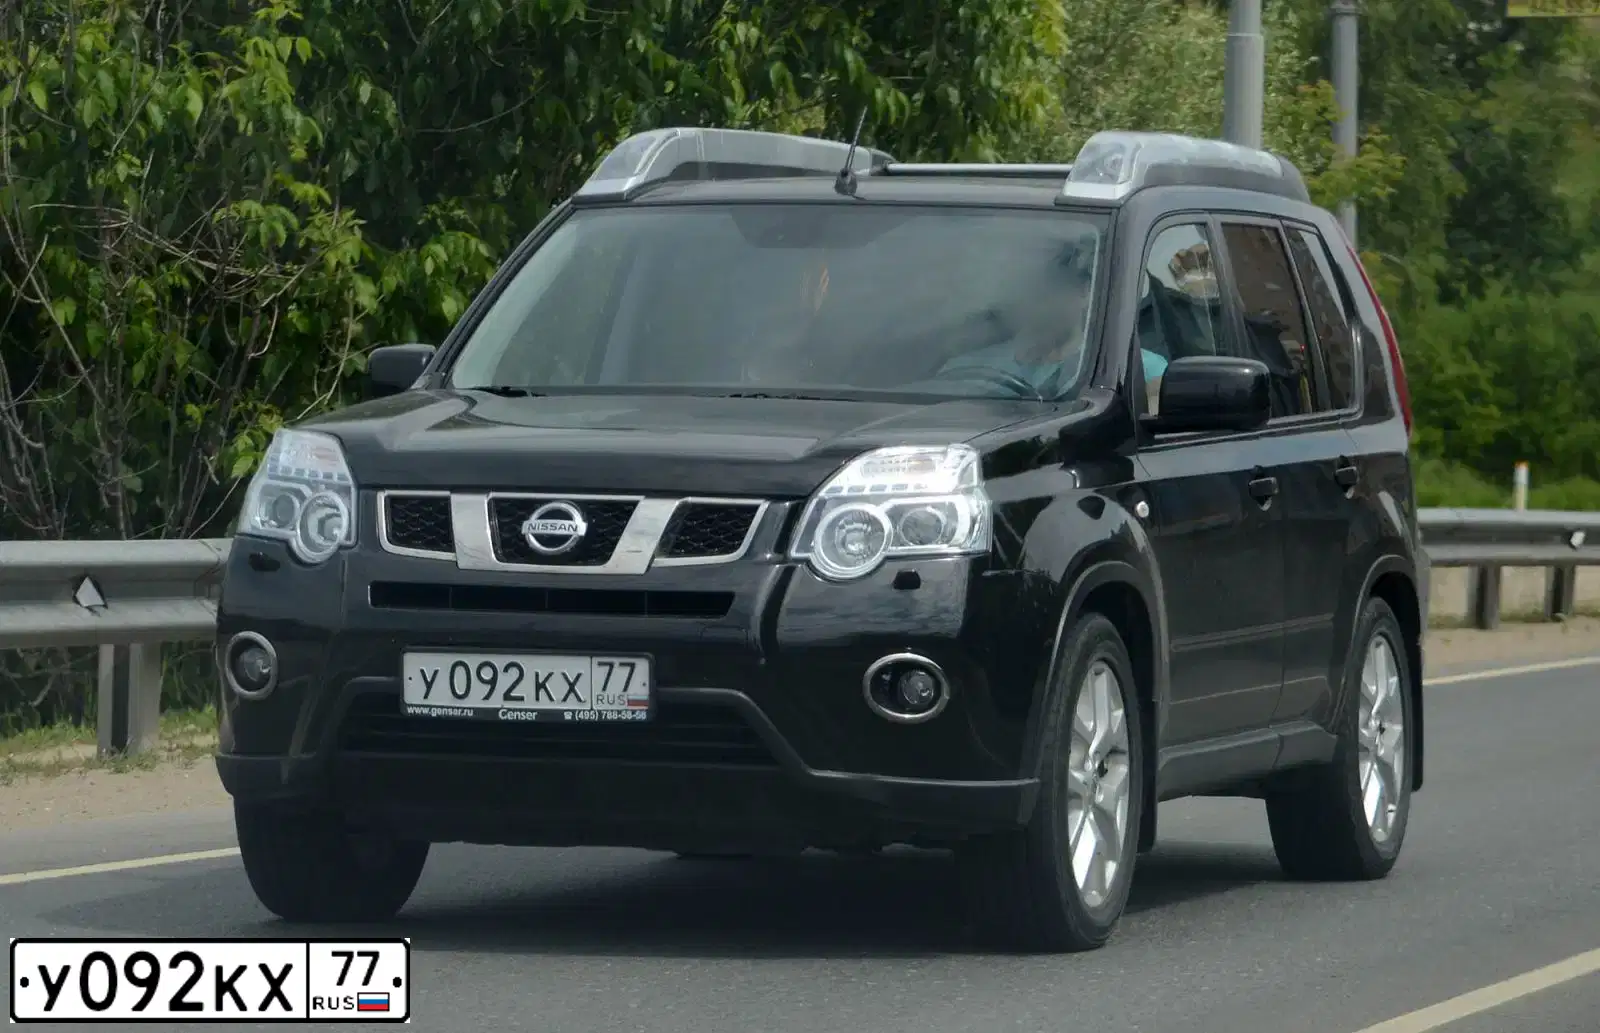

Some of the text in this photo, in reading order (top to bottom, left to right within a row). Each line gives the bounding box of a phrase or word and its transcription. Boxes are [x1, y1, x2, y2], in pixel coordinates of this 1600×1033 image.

[527, 522, 578, 533] NISSAN
[597, 661, 636, 692] 77
[596, 694, 626, 706] RUS
[575, 710, 599, 721] (495)
